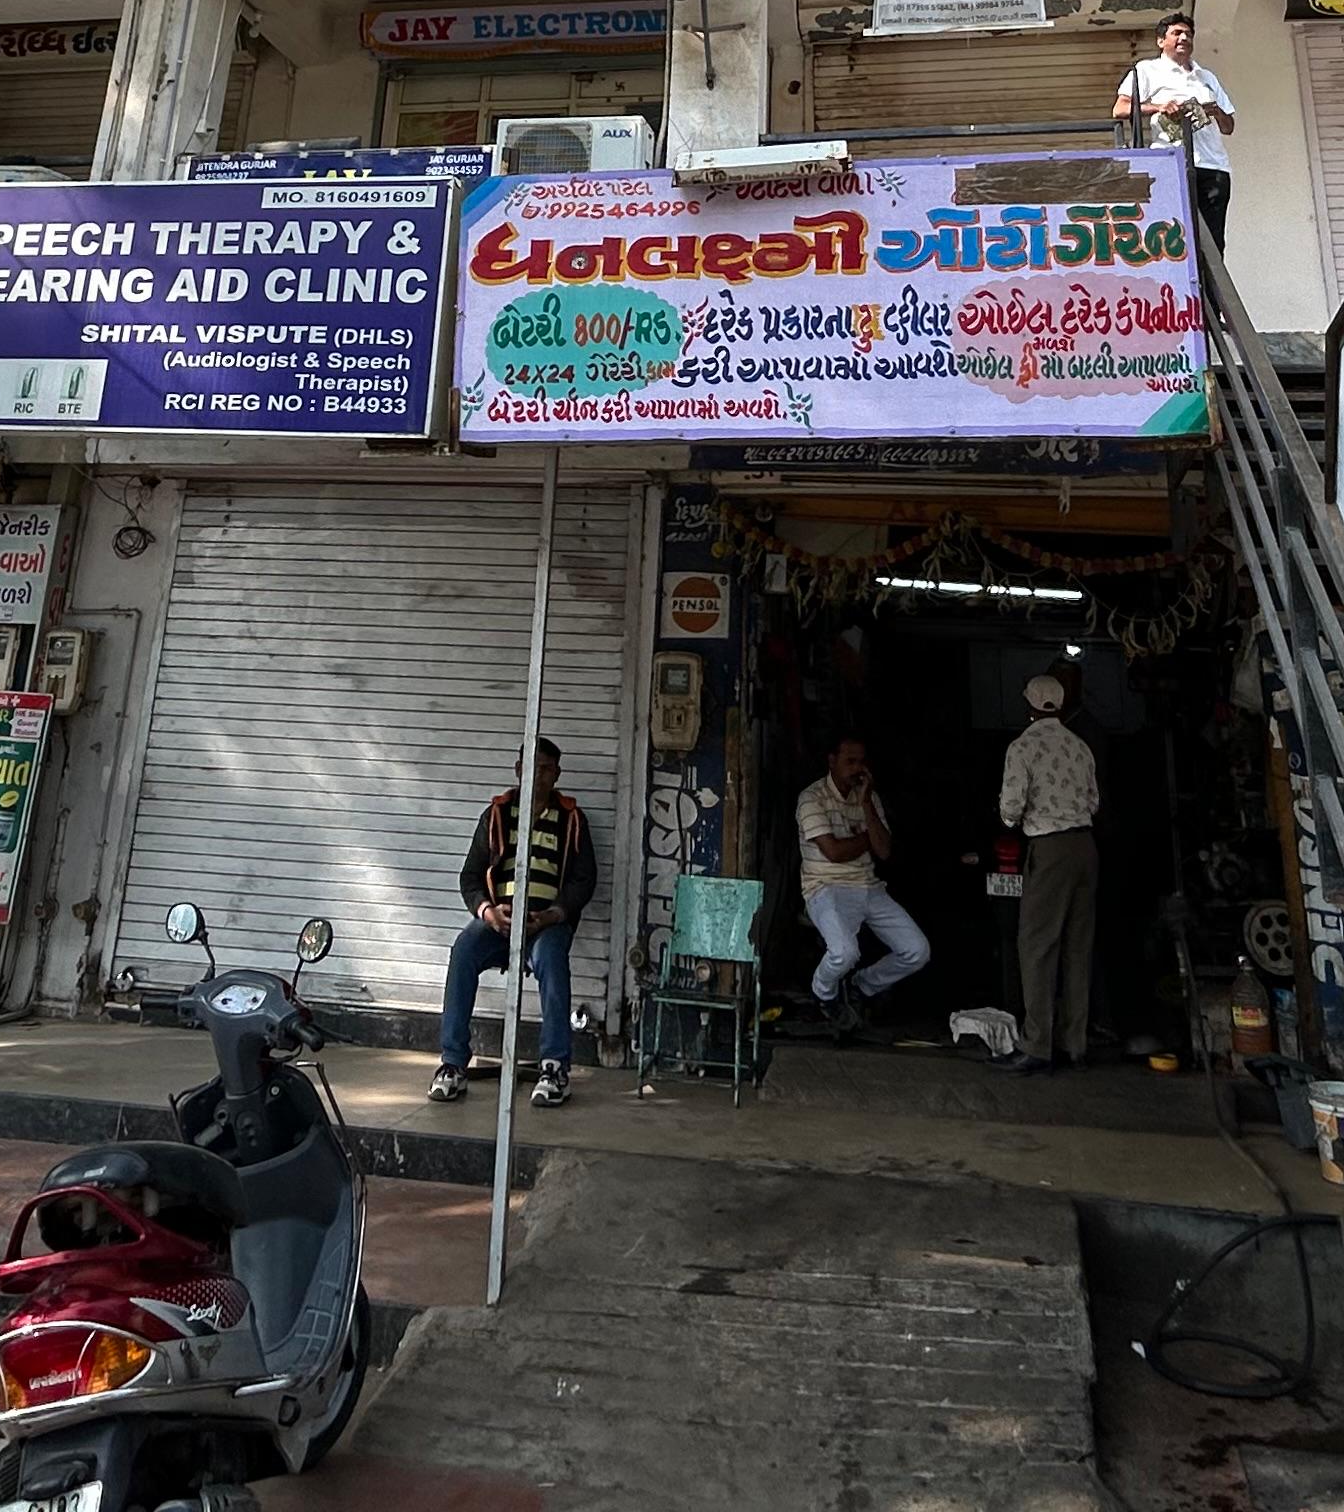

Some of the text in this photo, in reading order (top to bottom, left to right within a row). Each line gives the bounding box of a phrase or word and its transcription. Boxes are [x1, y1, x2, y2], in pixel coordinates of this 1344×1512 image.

[388, 8, 669, 44] JAY ELECTRON
[602, 128, 633, 139] AUX
[428, 154, 446, 165] JAY
[271, 189, 427, 205] MO. 8160491609
[149, 219, 374, 256] THERAPY
[386, 219, 422, 255] &
[468, 210, 870, 286] ધનલક્ષ્મી
[1053, 201, 1189, 268] ગેરેજ
[166, 268, 249, 304] AID
[263, 267, 429, 305] CLINIC
[703, 288, 753, 343] દરેક
[759, 304, 855, 344] પ્રકારના
[1060, 283, 1111, 334] દરેક
[80, 324, 414, 349] SHITAL VISPUTE (DHLS)
[163, 350, 412, 372] (Audiologist & Speech
[672, 345, 734, 387] કરી
[737, 351, 872, 381] આપવામાં
[874, 340, 959, 379] આવશે
[1117, 345, 1195, 379] આપવામાં
[294, 373, 410, 394] Therapist)
[13, 402, 35, 415] RIC
[57, 402, 82, 415] BTE
[164, 393, 408, 416] RCI REG NO B44933
[601, 388, 633, 424] કરી
[671, 598, 721, 612] PENSOL
